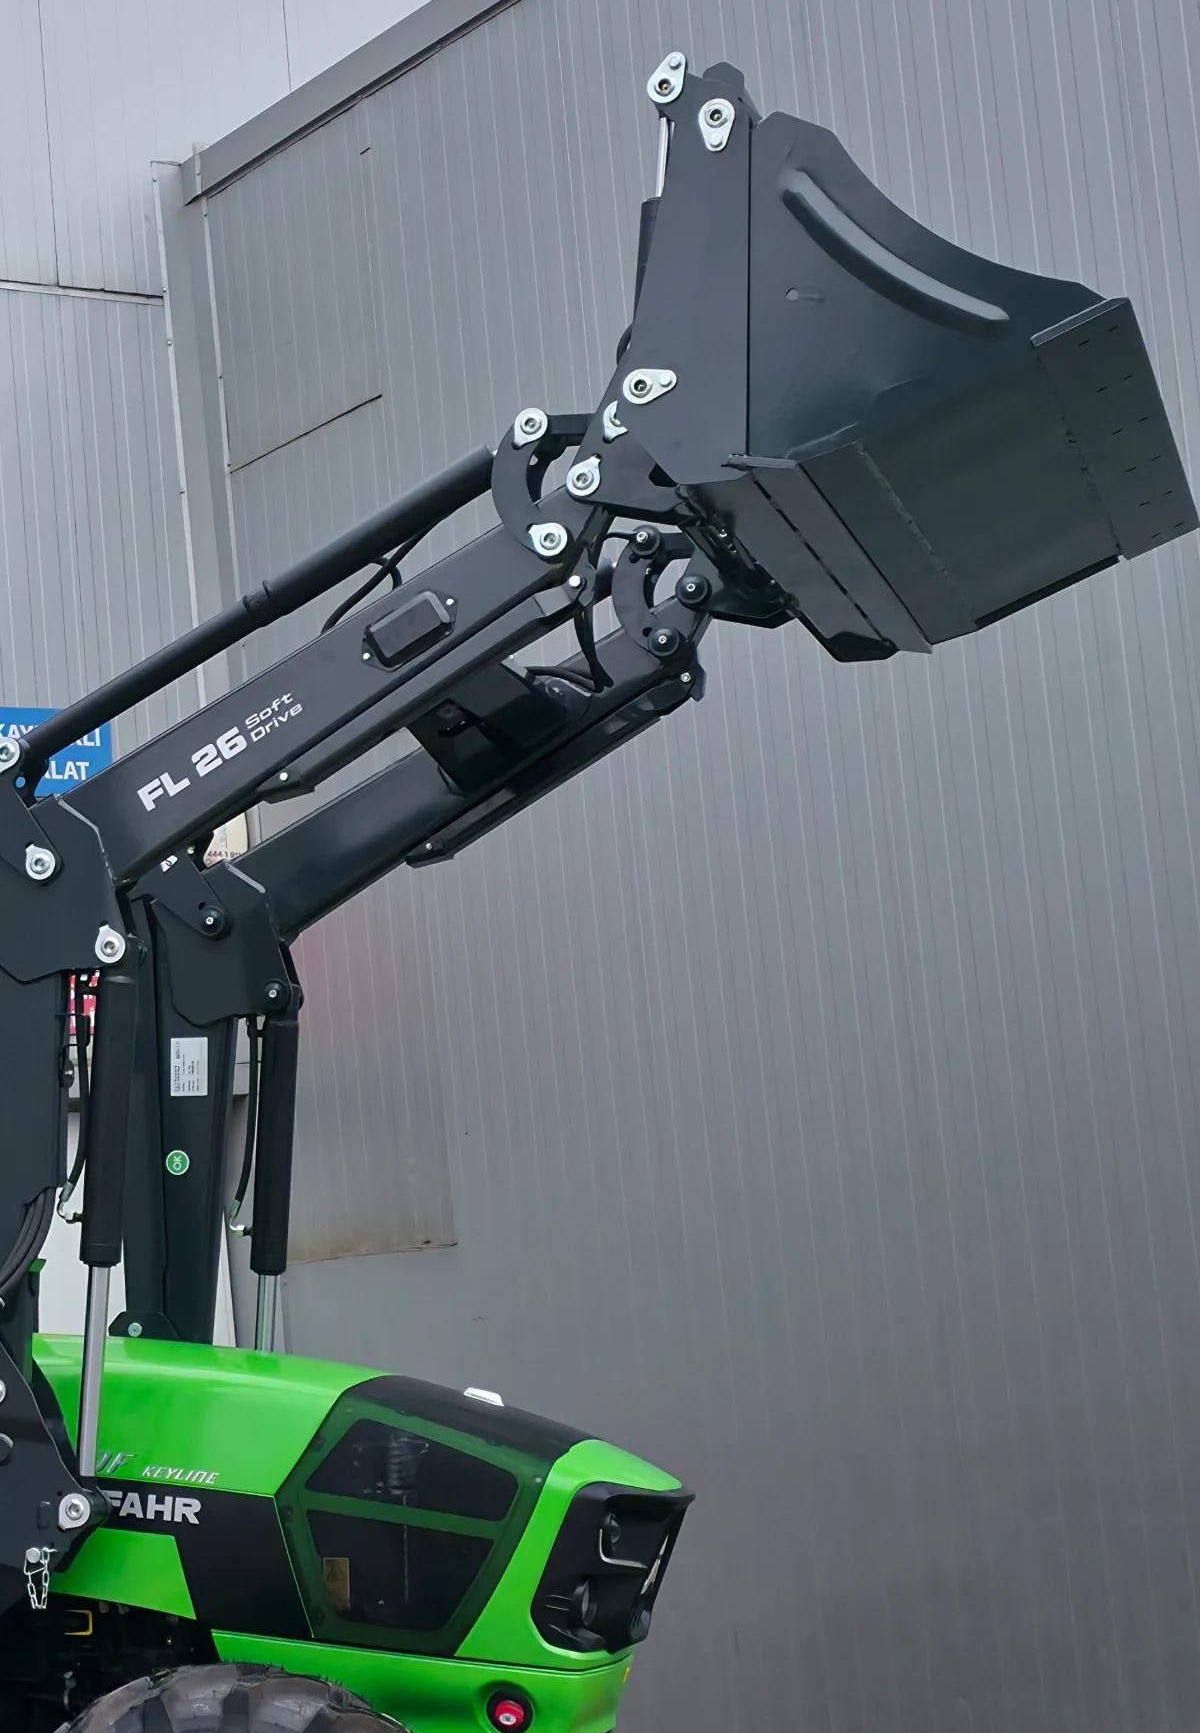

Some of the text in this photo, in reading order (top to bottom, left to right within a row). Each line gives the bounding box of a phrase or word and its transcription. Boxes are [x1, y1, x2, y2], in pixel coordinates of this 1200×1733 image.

[245, 692, 294, 730] Soft
[250, 703, 303, 743] Drive
[137, 726, 248, 812] FL 26
[173, 1155, 182, 1171] OK
[142, 1466, 220, 1484] KEYLINE
[104, 1489, 202, 1525] FAHR
